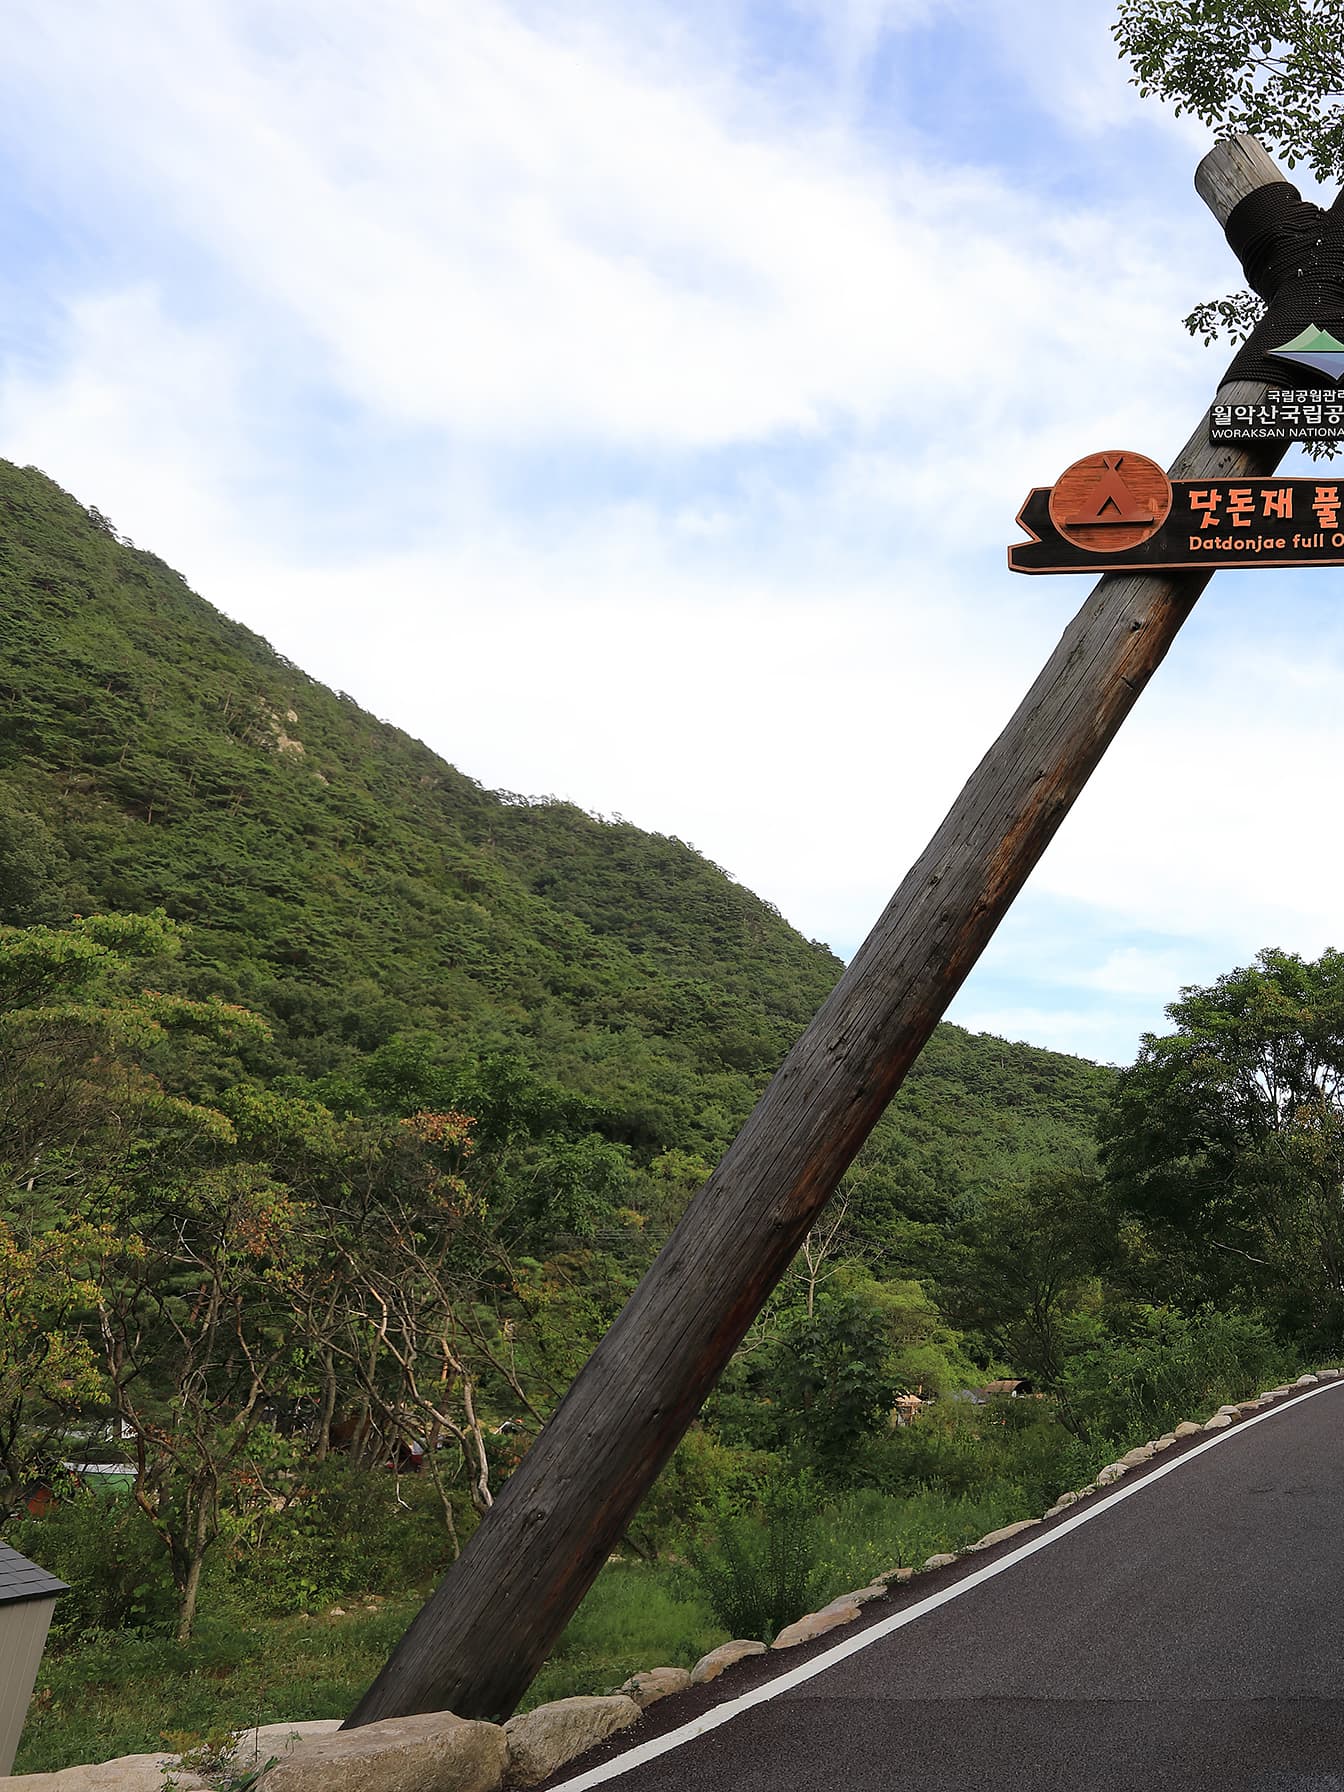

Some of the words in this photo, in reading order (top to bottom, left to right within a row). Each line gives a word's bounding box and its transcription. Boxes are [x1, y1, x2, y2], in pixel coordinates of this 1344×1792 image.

[1211, 428, 1285, 439] WORAKSAN
[1188, 487, 1294, 529] 닷돈재
[1189, 535, 1286, 553] Datdonjae
[1292, 533, 1324, 549] full
